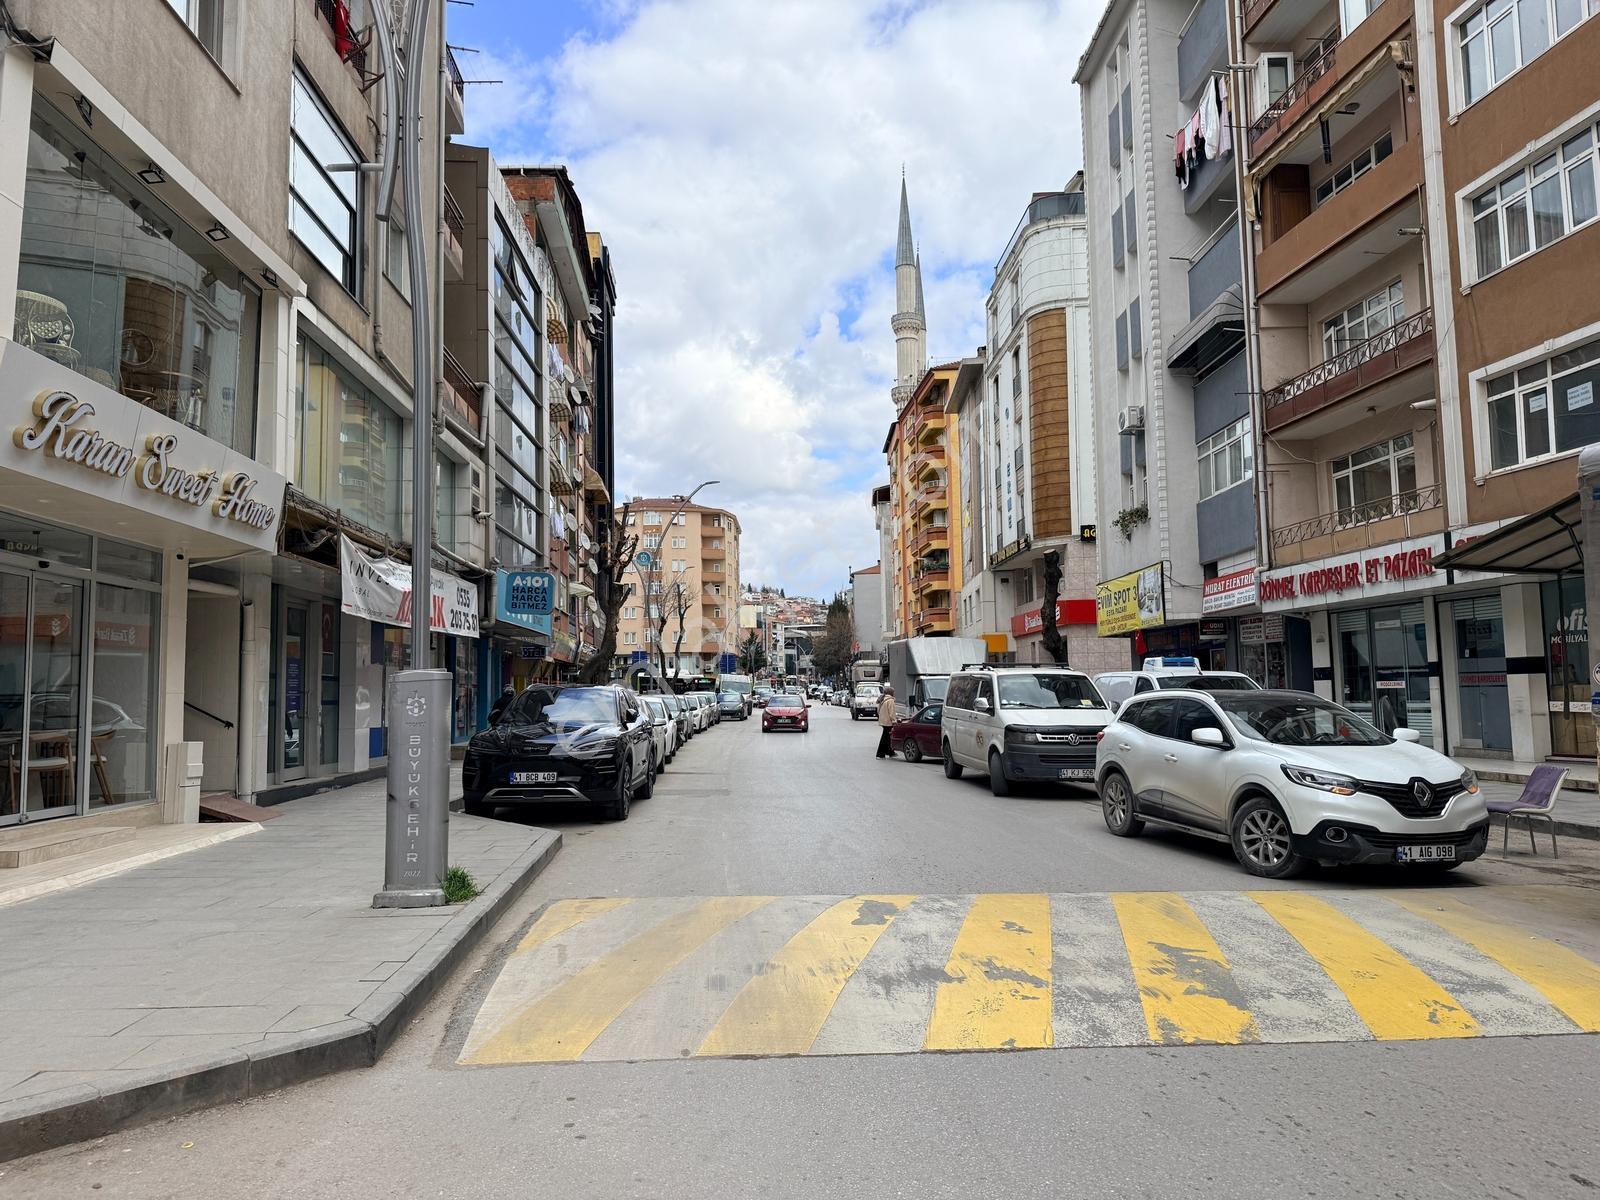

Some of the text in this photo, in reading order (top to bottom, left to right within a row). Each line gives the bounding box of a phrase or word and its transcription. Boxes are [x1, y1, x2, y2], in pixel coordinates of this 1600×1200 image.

[15, 390, 275, 531] Karan Sweet Home
[1260, 547, 1436, 602] DÖNMEZ KARDEŞLER ET PAZARI
[512, 587, 548, 595] HARCA
[1205, 582, 1225, 595] MURAT
[511, 594, 548, 603] HARCA
[1113, 587, 1131, 606] SPOT
[450, 608, 462, 629] 203
[514, 773, 522, 781] 41
[542, 773, 556, 781] 409
[1402, 846, 1412, 858] 41
[1436, 846, 1453, 857] 098
